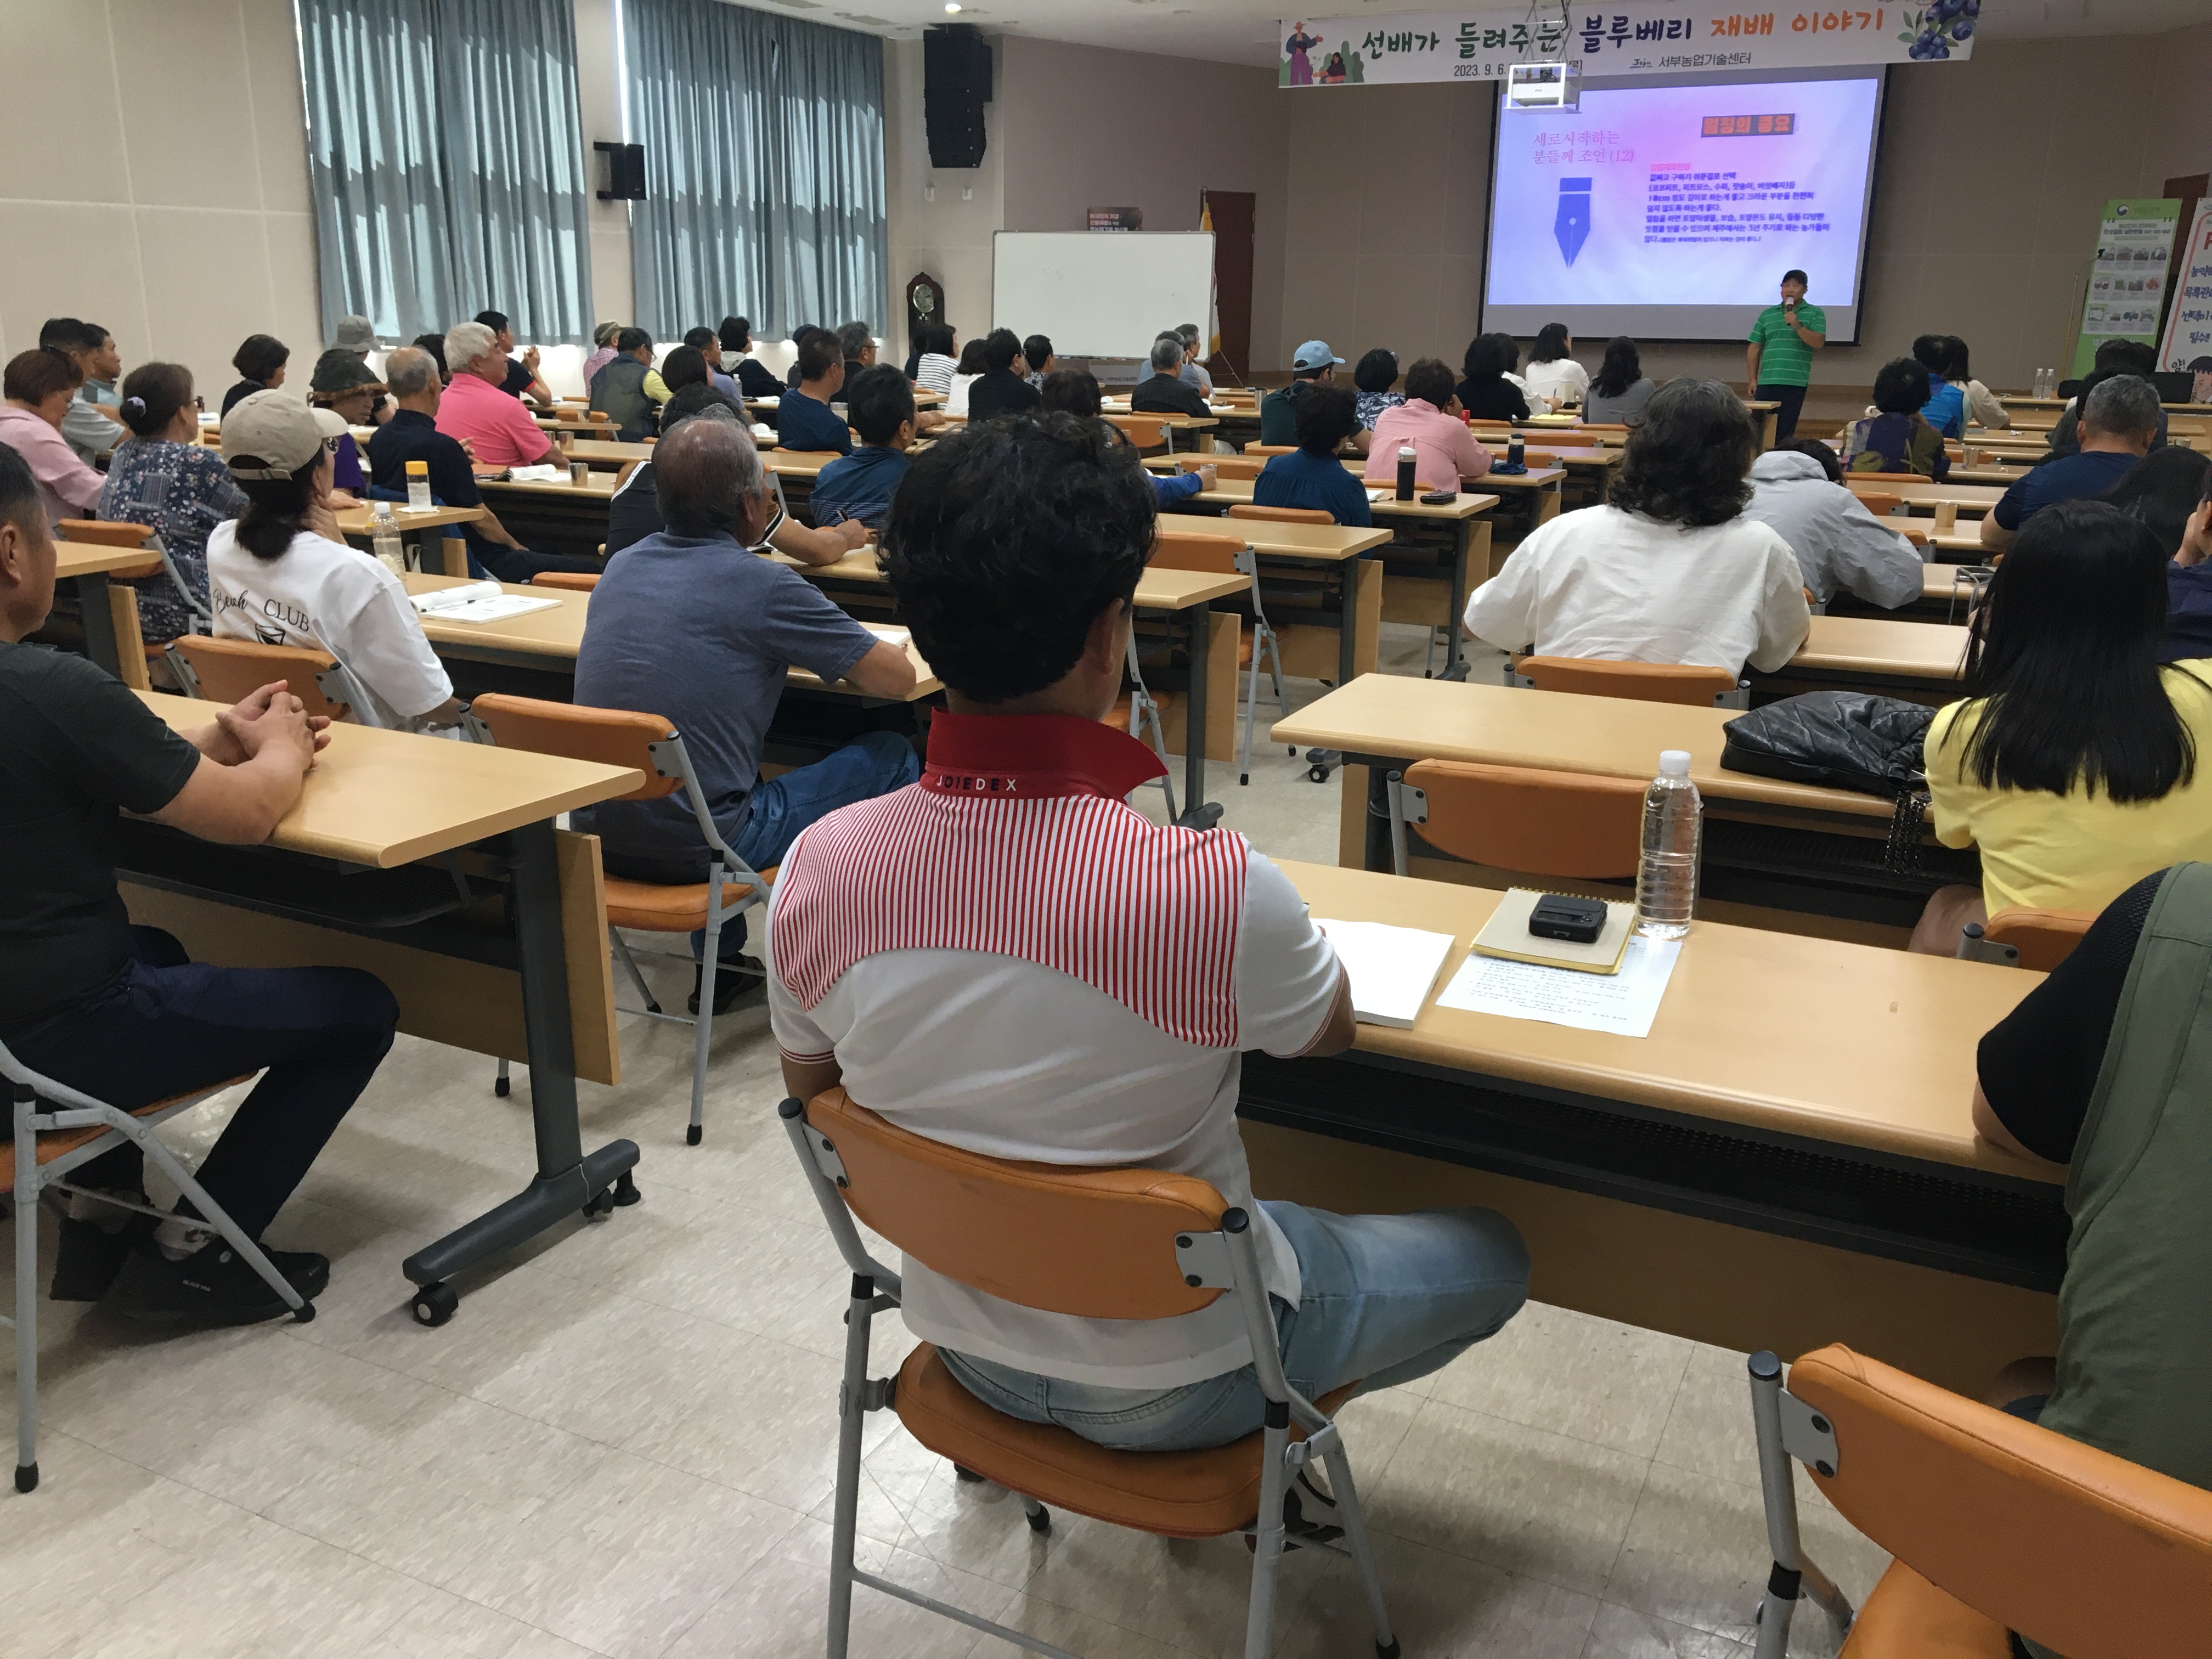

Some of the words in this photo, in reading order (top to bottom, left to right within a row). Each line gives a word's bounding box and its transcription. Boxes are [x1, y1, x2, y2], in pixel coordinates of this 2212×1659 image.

[1362, 29, 1440, 59] 선배가
[1455, 19, 1561, 59] 들려주는
[1579, 14, 1692, 53] 블루베리
[1711, 13, 1774, 37] 재배
[1791, 8, 1883, 34] 이야기
[1657, 52, 1751, 67] 서부농업기술센터
[1454, 64, 1480, 76] 2023.
[1485, 63, 1494, 76] 9.
[1498, 63, 1506, 75] 6.
[1533, 129, 1620, 146] 새로시작하는
[1532, 149, 1574, 165] 분들께
[1577, 148, 1606, 163] 조언
[1610, 148, 1634, 164] (12)
[263, 598, 309, 631] CLUB
